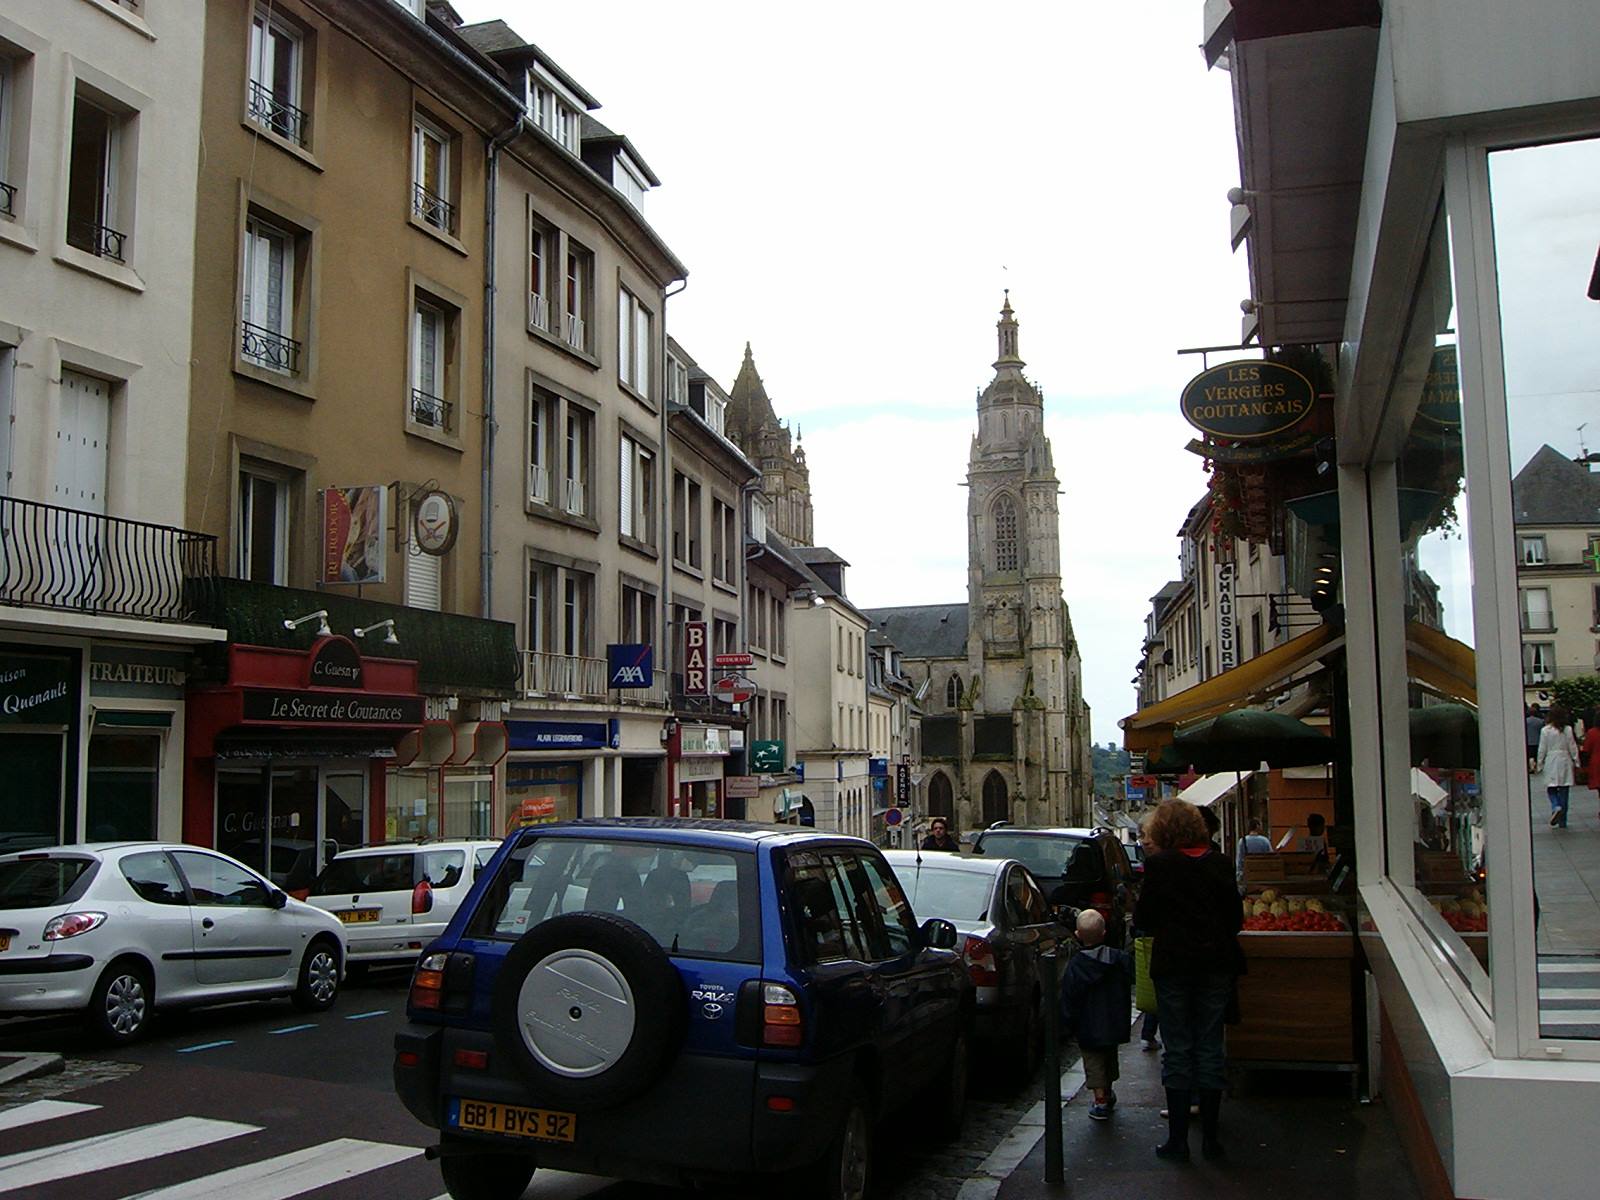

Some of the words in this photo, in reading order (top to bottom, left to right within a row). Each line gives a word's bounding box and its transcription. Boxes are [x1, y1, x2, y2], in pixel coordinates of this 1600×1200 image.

[1228, 367, 1260, 381] LES
[1204, 383, 1286, 401] VERGERS
[687, 628, 705, 690] BAR
[715, 656, 751, 664] RESTAURANT
[91, 661, 179, 685] TRAITEUR
[612, 666, 645, 683] AXA
[3, 680, 68, 714] Quenault
[271, 697, 288, 717] Le
[289, 698, 329, 719] Secret
[330, 700, 345, 719] de
[347, 700, 403, 720] Coutances
[699, 983, 724, 991] TOYOTA
[464, 1103, 498, 1129] 681
[504, 1108, 540, 1134] BYS
[546, 1114, 570, 1139] 92
